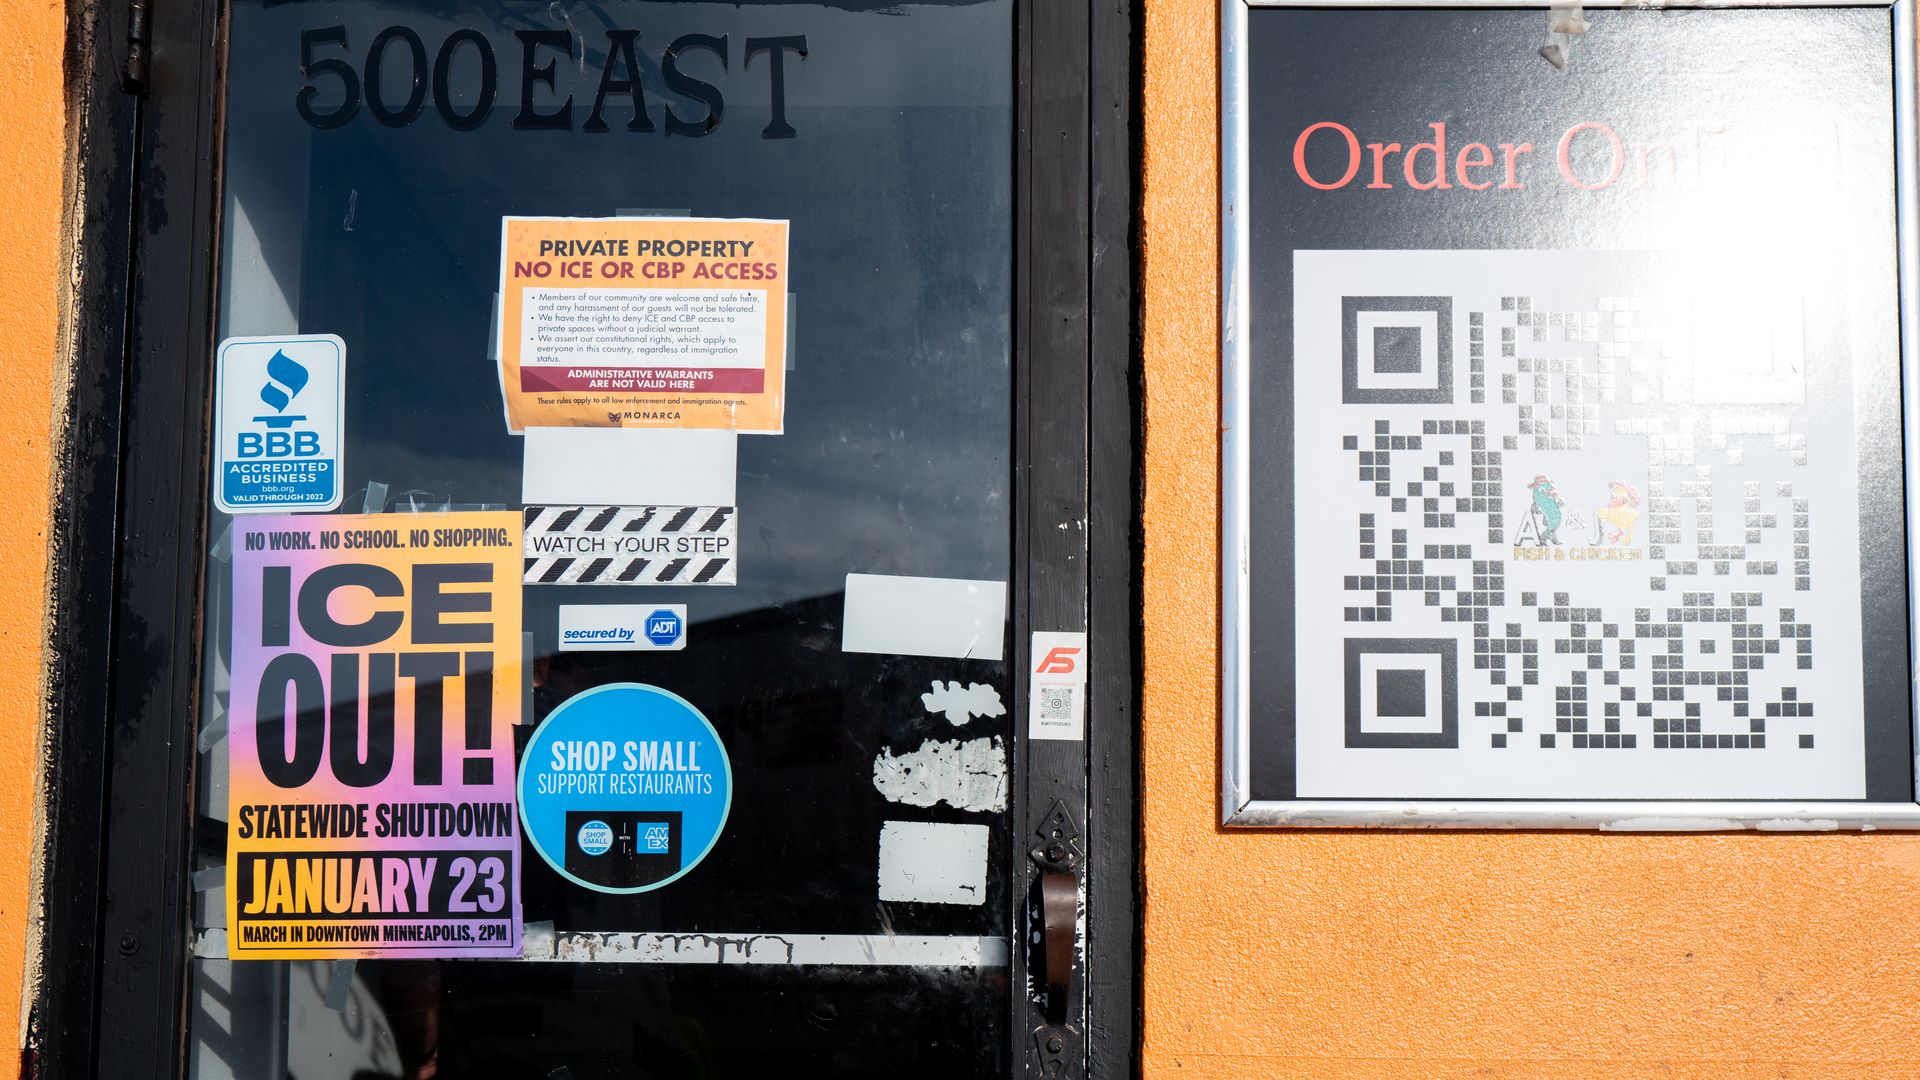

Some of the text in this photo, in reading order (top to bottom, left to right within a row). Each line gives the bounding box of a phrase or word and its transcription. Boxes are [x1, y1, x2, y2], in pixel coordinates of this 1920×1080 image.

[296, 24, 809, 139] 500 EAST
[1293, 121, 1531, 190] Order
[540, 240, 755, 257] PRIVATE PROPERTY
[514, 261, 778, 280] NO ICE OR CBP ACCESS
[539, 293, 575, 301] Members
[578, 293, 587, 301] of
[604, 294, 646, 303] community
[665, 294, 700, 302] welcome
[702, 294, 718, 302] and
[721, 294, 737, 302] safe
[740, 295, 760, 303] here,
[539, 303, 554, 311] and
[556, 305, 572, 313] any
[574, 304, 619, 312] harassment
[621, 304, 630, 312] of
[647, 305, 672, 314] guests
[674, 304, 689, 312] will
[706, 305, 716, 313] be
[719, 305, 756, 313] tolerated.
[538, 313, 553, 322] We
[556, 314, 575, 322] have
[577, 314, 590, 322] the
[592, 314, 611, 324] right
[622, 314, 642, 324] deny
[645, 314, 659, 322] ICE
[661, 314, 677, 322] and
[679, 315, 696, 323] CBP
[538, 325, 566, 334] private
[636, 325, 666, 334] judicial
[538, 335, 553, 343] We
[554, 335, 578, 343] assert
[596, 335, 647, 343] constitutional
[650, 335, 674, 345] rights,
[677, 336, 701, 344] which
[703, 336, 726, 346] apply
[537, 345, 738, 355] everyone in this country, regardless of immigration
[537, 355, 561, 363] status.
[567, 369, 714, 380] ADMINISTRATIVE WARRANTS
[589, 380, 695, 389] ARE NOT VALID HERE
[538, 397, 555, 405] These
[573, 397, 591, 405] apply
[625, 397, 666, 405] enforcement
[667, 397, 681, 405] and
[682, 398, 722, 406] immigration
[624, 411, 681, 420] MONARCA
[238, 431, 320, 458] BBB
[230, 462, 328, 473] ACCREDITED
[241, 473, 316, 484] BUSINESS
[262, 485, 295, 493] bbb.org
[245, 528, 513, 551] NO WORK. NO SCHOOL. NO SHOPPING.
[533, 537, 729, 553] WATCH YOUR STEP
[1513, 547, 1641, 561] FISH & CHICKEN
[262, 563, 494, 647] ICE
[563, 628, 635, 640] secured by
[651, 621, 676, 634] ADT
[256, 651, 494, 788] OUT!
[551, 741, 701, 772] SHOP SMALL
[537, 773, 713, 794] SUPPORT RESTAURANTS
[238, 802, 512, 839] STATEWIDE SHUTDOWN
[243, 856, 505, 914] JANUARY 23
[243, 924, 507, 944] MARCH IN DOWNTOWN MINNEAPOLIS, 2PM
